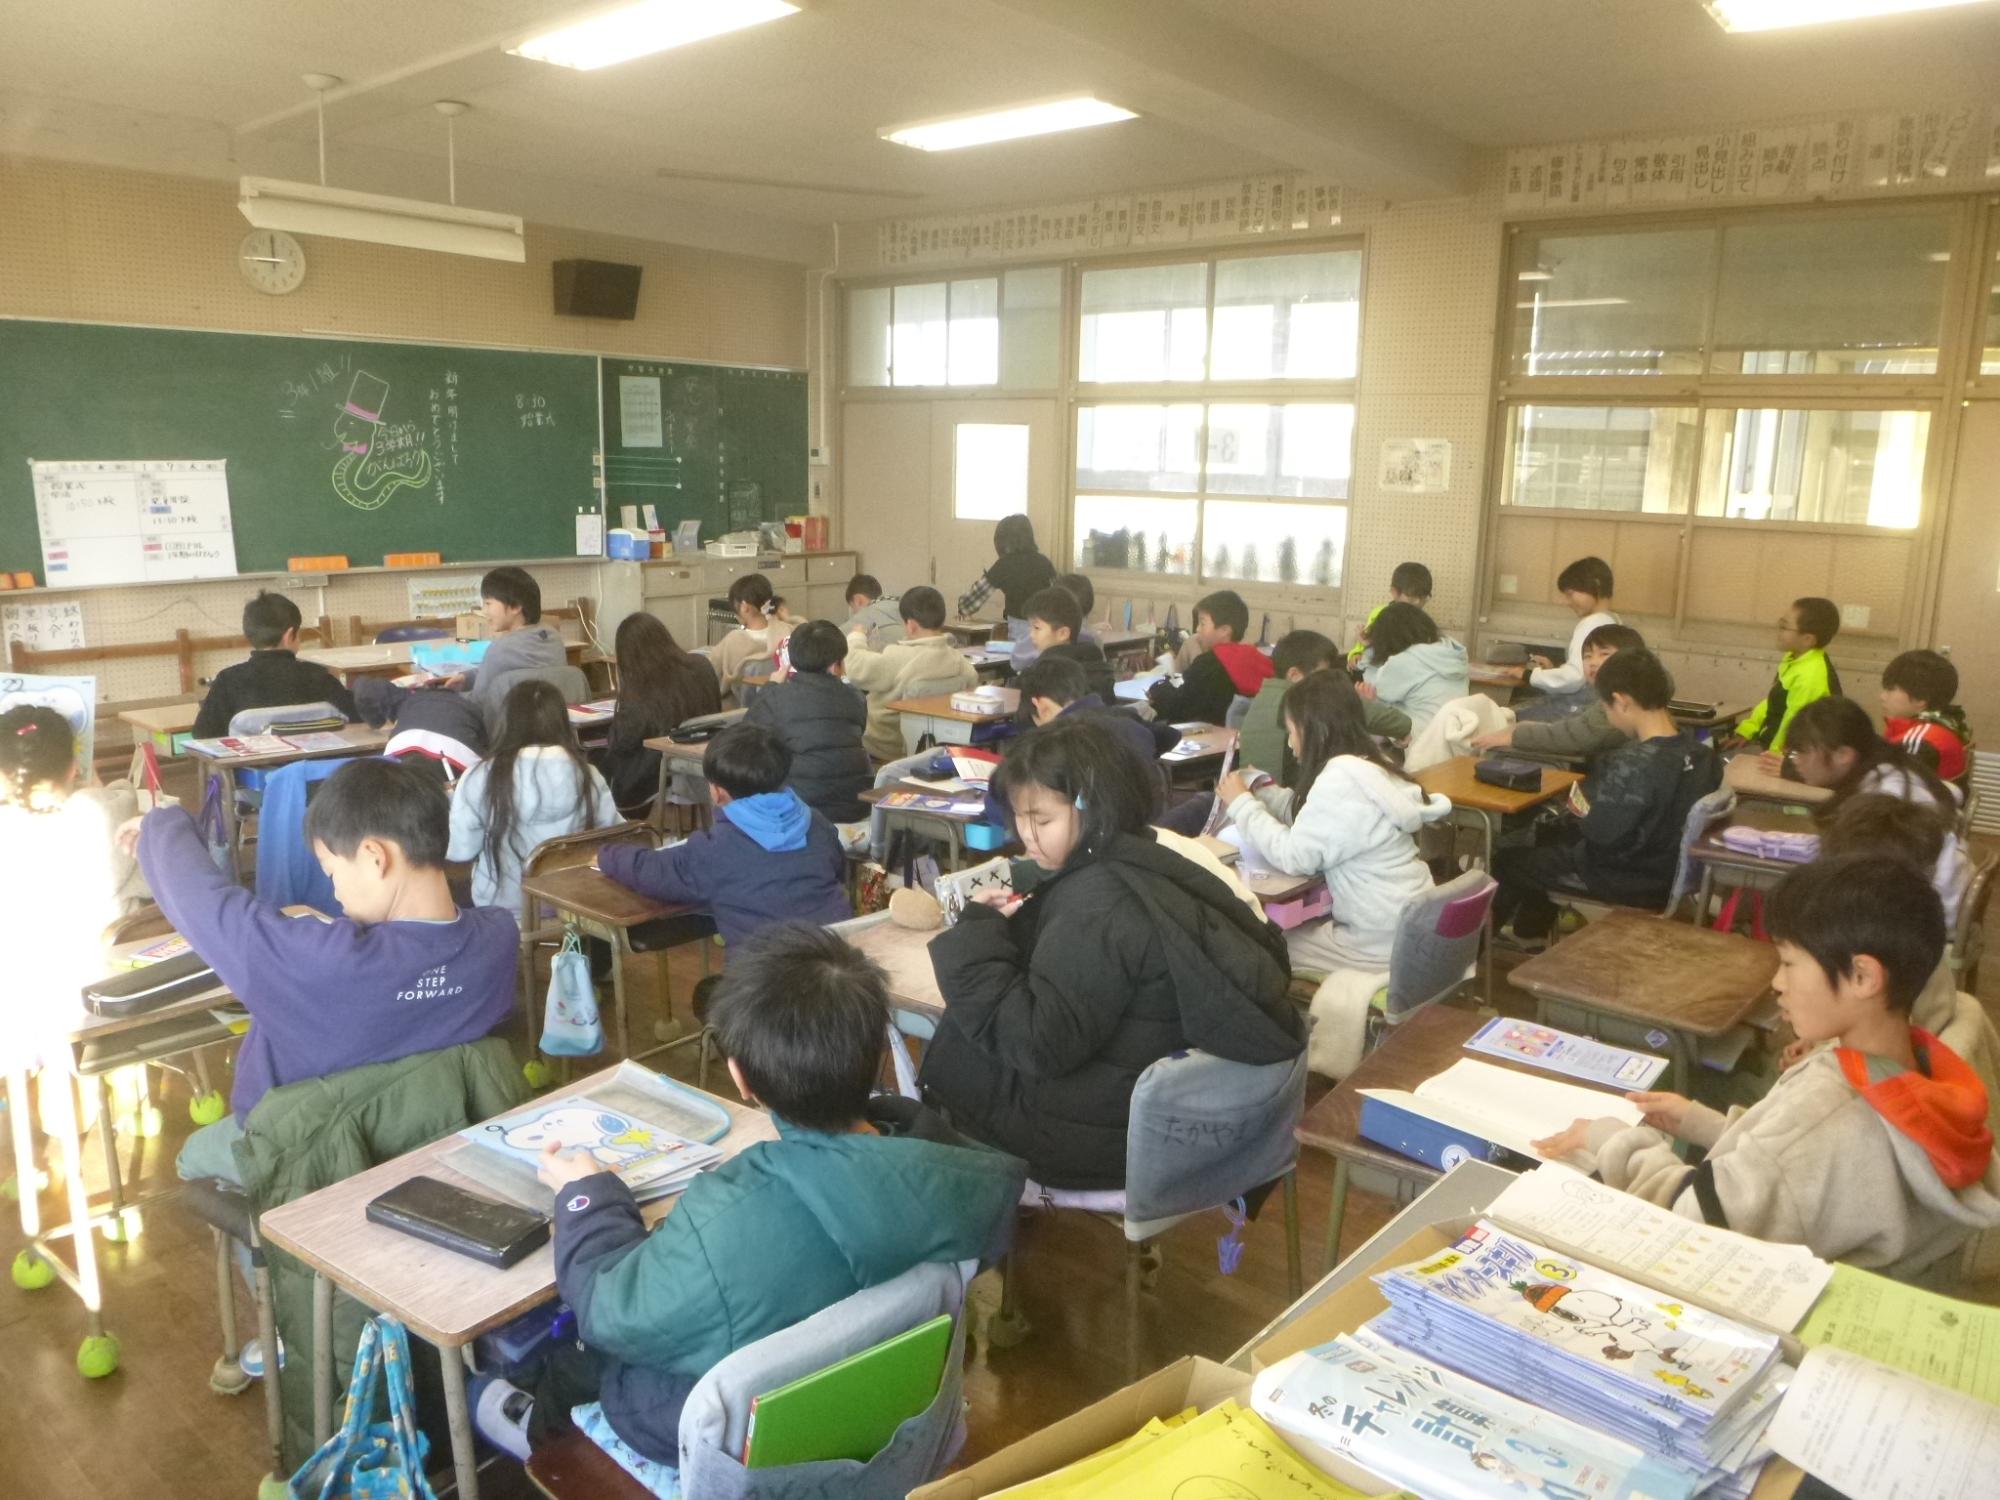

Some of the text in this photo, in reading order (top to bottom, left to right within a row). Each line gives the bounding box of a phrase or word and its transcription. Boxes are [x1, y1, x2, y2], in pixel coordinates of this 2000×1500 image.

[1695, 145, 1710, 188] 見出し
[1711, 135, 1730, 193] 小見出し
[1738, 132, 1756, 192] 組み立て
[396, 986, 463, 1001] FORWARD
[416, 976, 446, 988] STEP
[1541, 1263, 1570, 1278] 3
[1308, 1395, 1338, 1419] 冬の
[1505, 1438, 1569, 1469] 3
